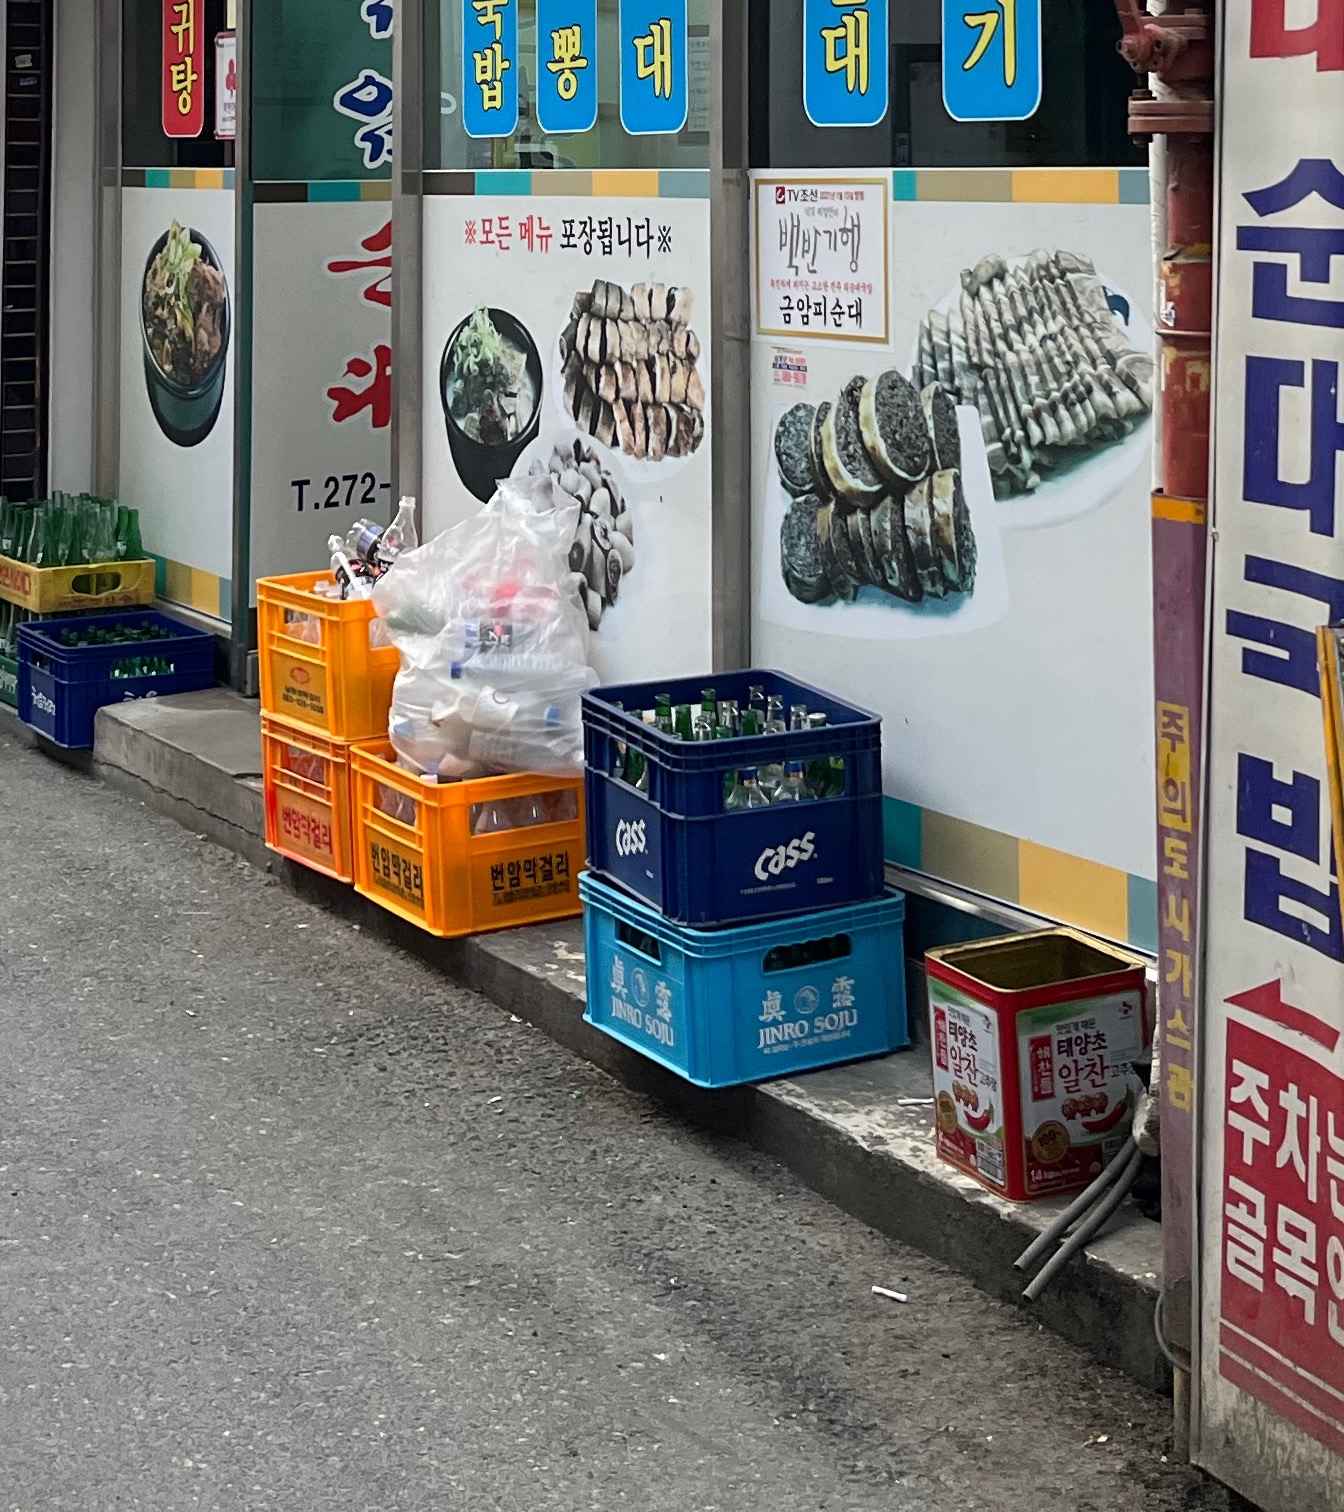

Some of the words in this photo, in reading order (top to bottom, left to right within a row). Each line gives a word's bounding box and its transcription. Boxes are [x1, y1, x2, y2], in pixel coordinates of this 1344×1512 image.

[519, 213, 554, 253] 메뉴
[778, 205, 861, 276] 백반기행
[779, 293, 863, 329] 금암피순대
[1160, 707, 1186, 826] 주의
[282, 804, 334, 855] 번암막걸리
[370, 842, 424, 897] 번암막걸리
[490, 851, 570, 892] 번암막걸리
[612, 995, 643, 1029] JINRO
[645, 1013, 675, 1047] SOJU
[757, 1019, 809, 1049] JINRO
[813, 1009, 858, 1034] SOJU
[1057, 1032, 1108, 1058] 태양초
[1058, 1054, 1110, 1094] 알찬
